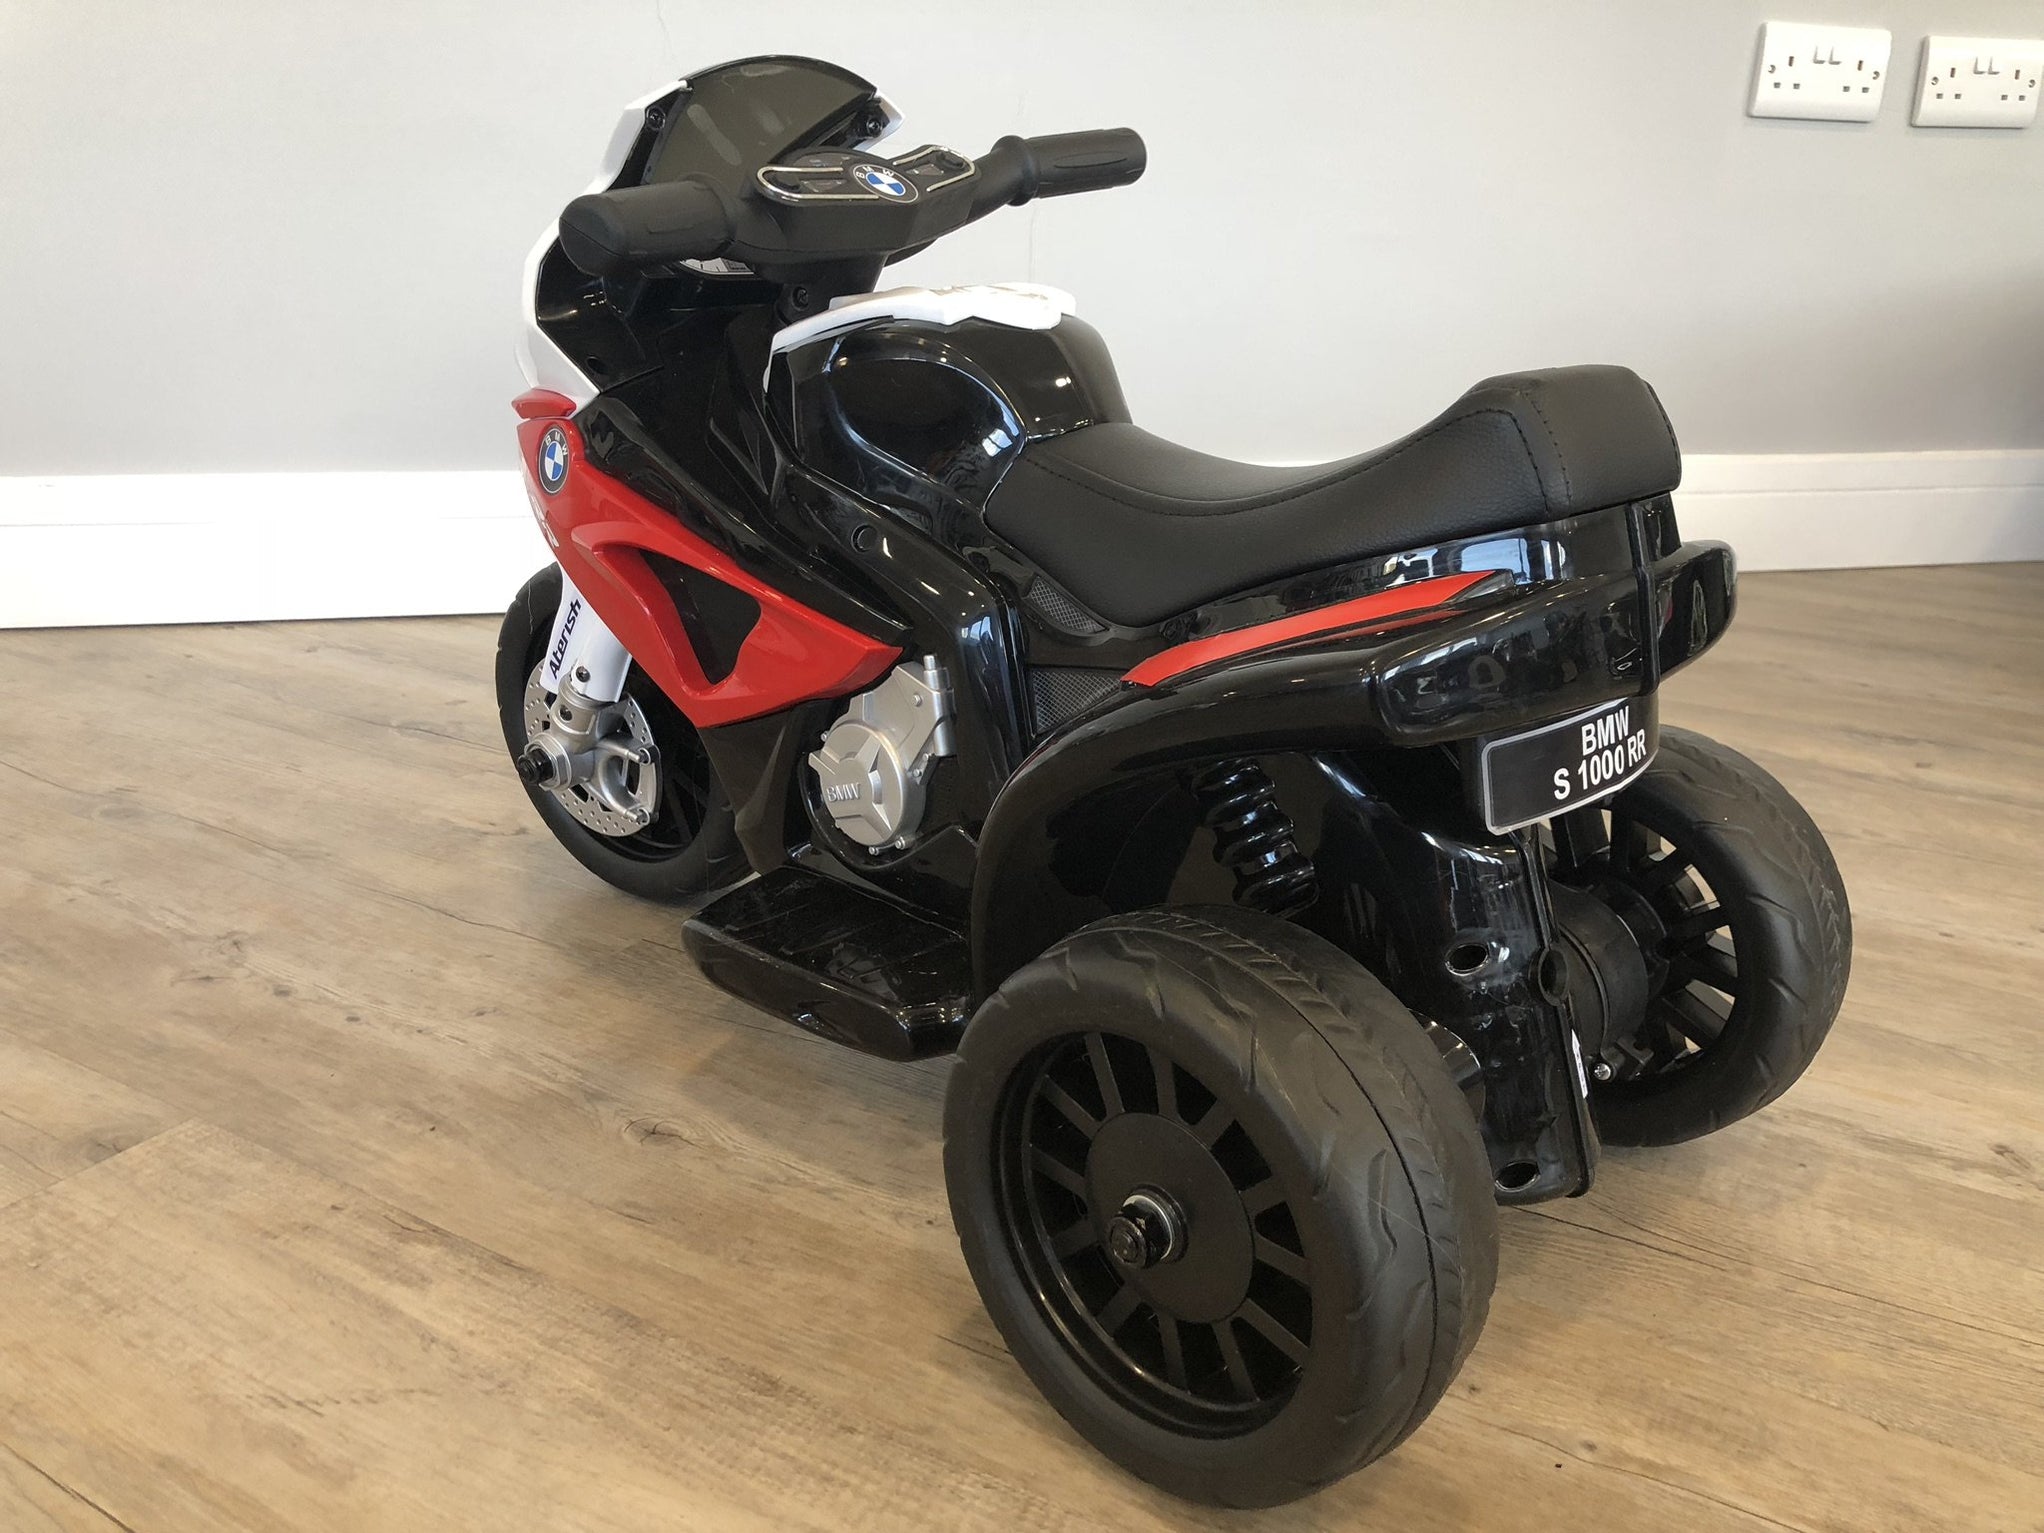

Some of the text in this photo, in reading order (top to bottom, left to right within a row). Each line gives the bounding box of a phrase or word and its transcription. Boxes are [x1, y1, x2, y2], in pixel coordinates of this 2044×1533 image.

[855, 165, 896, 180] BMW
[543, 431, 569, 457] BMW
[1581, 705, 1630, 756] BMW
[1553, 728, 1647, 800] S 1000 RR
[825, 782, 862, 802] BMW
